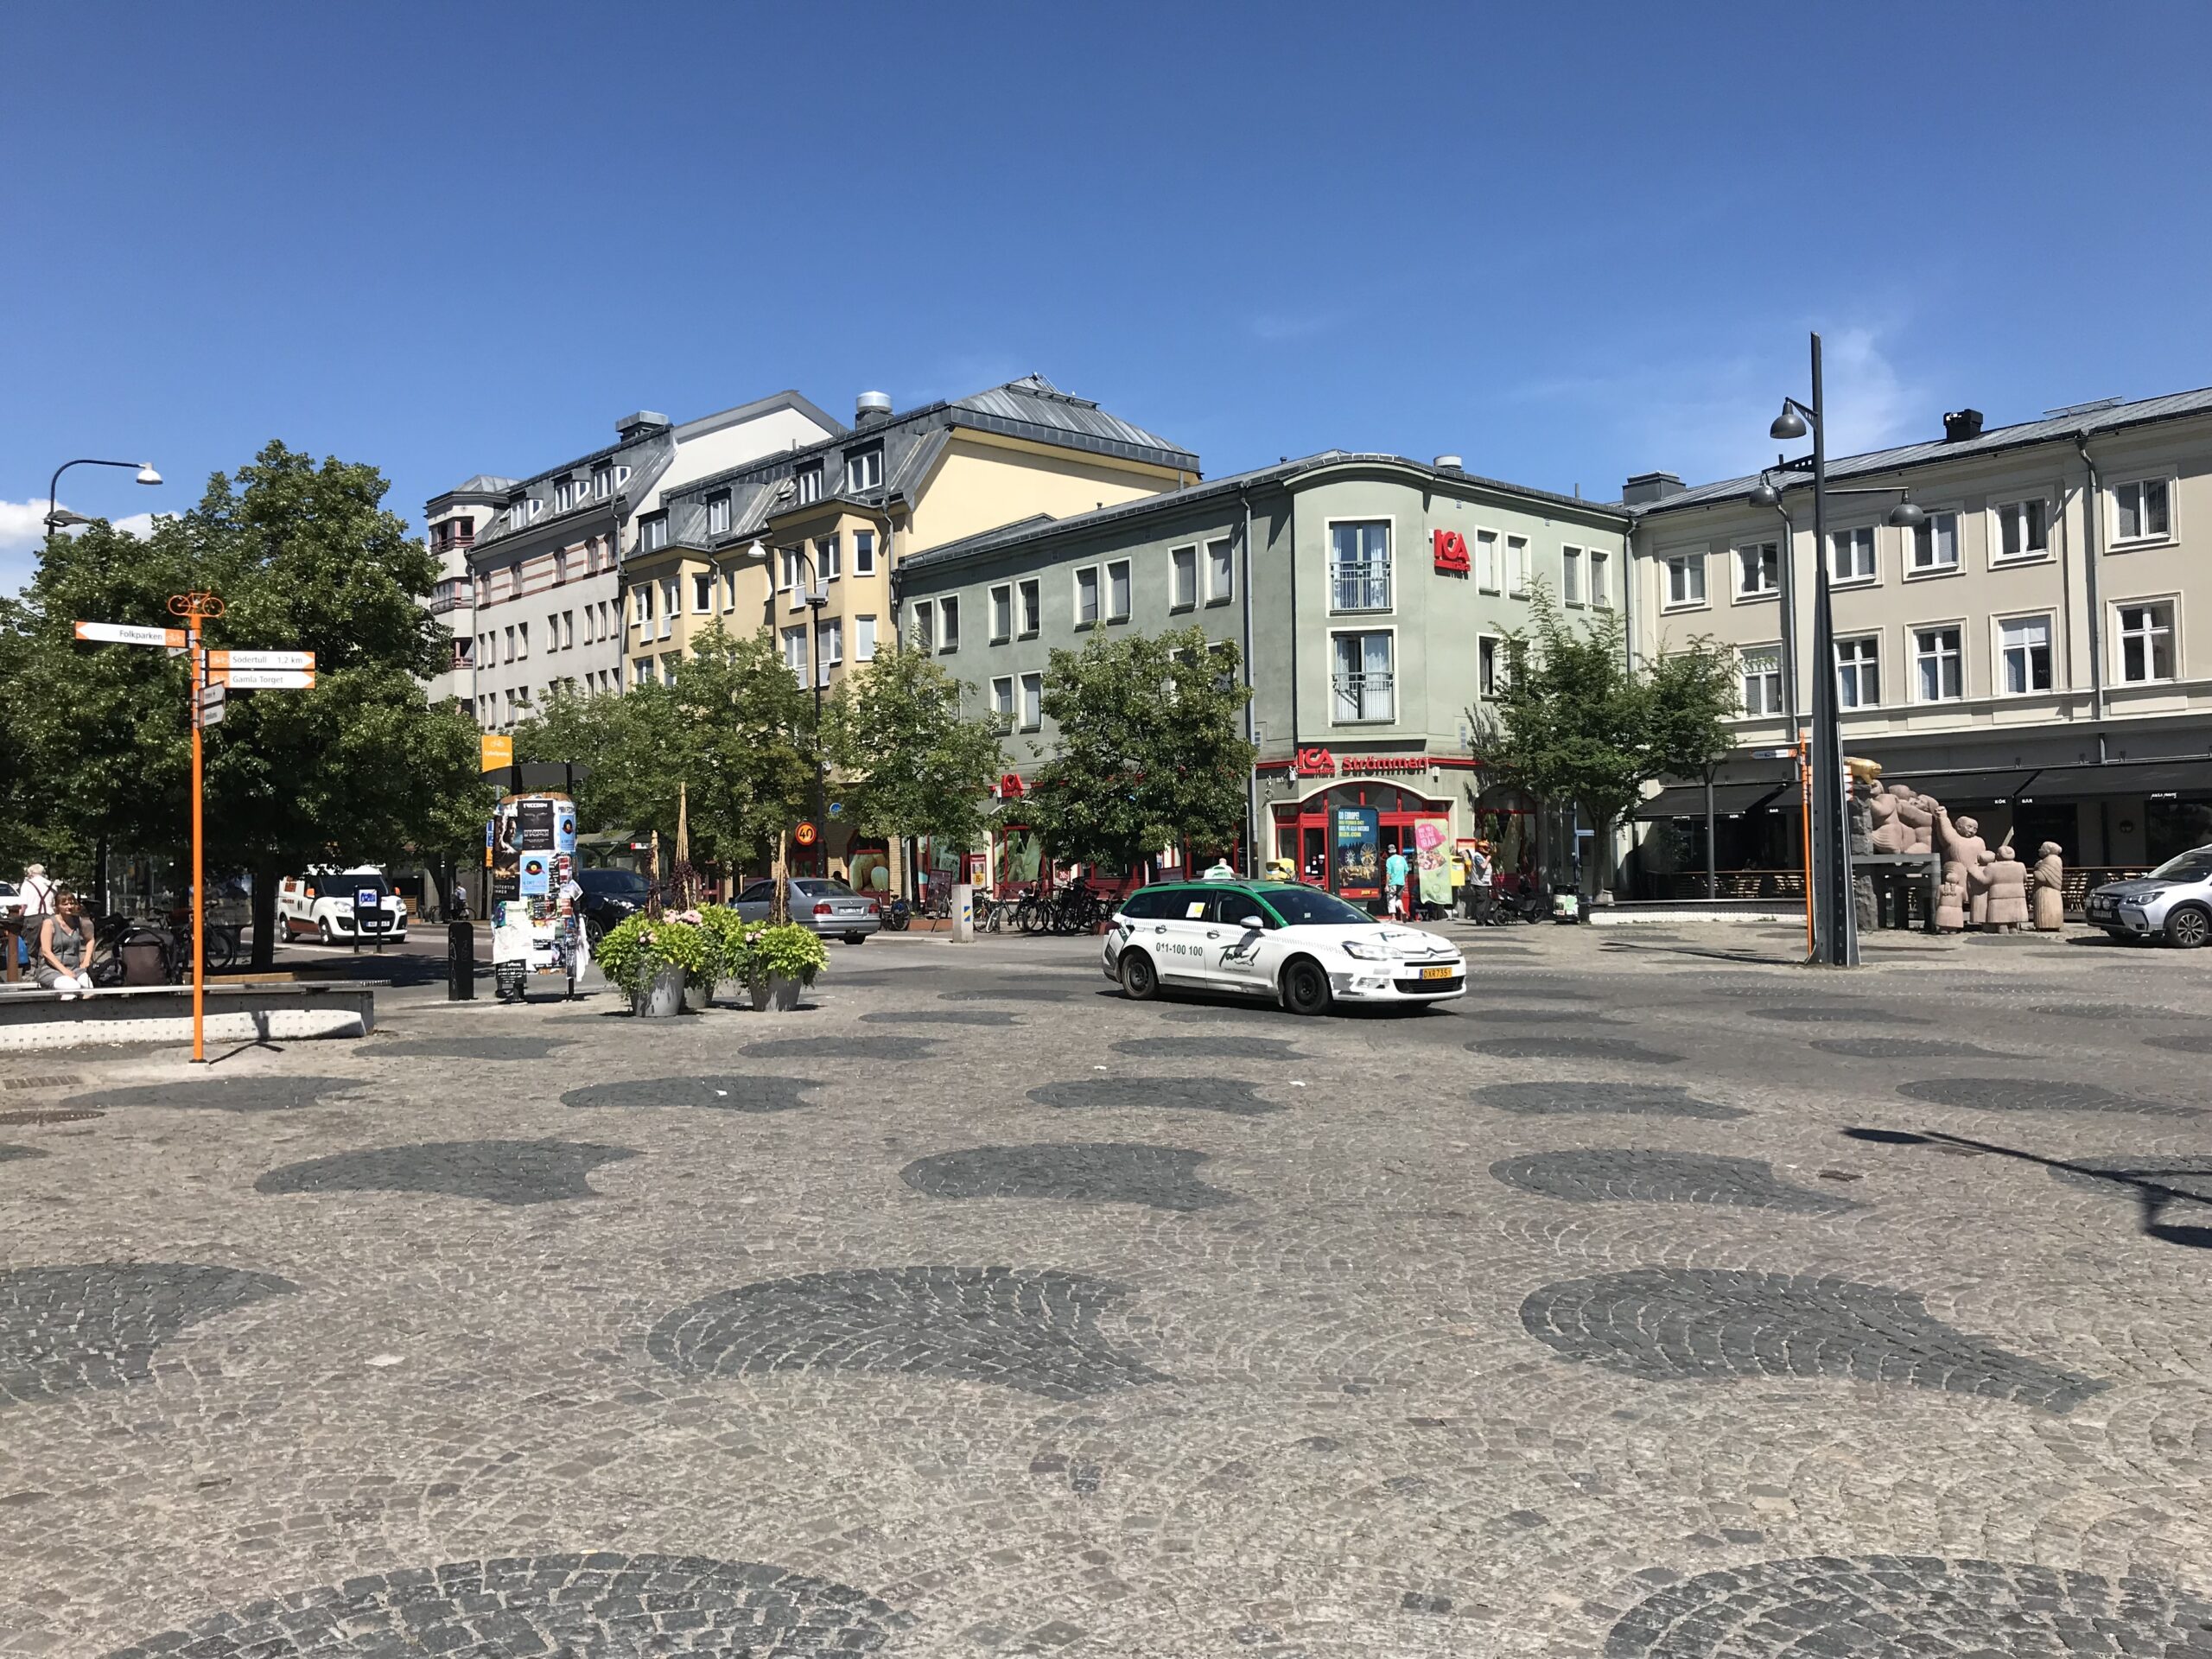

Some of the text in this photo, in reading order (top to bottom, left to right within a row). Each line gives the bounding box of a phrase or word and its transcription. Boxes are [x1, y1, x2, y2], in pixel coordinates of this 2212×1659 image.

[1434, 529, 1471, 562] ICA
[119, 629, 162, 642] Folkparken
[232, 655, 267, 664] Södertull
[232, 675, 283, 685] Gamla Torget
[1298, 748, 1334, 766] ICA
[1342, 756, 1429, 771] Strömmen
[1001, 774, 1023, 791] ICA
[798, 825, 814, 840] 40
[1189, 946, 1204, 957] 100
[1423, 969, 1448, 979] DXR735
